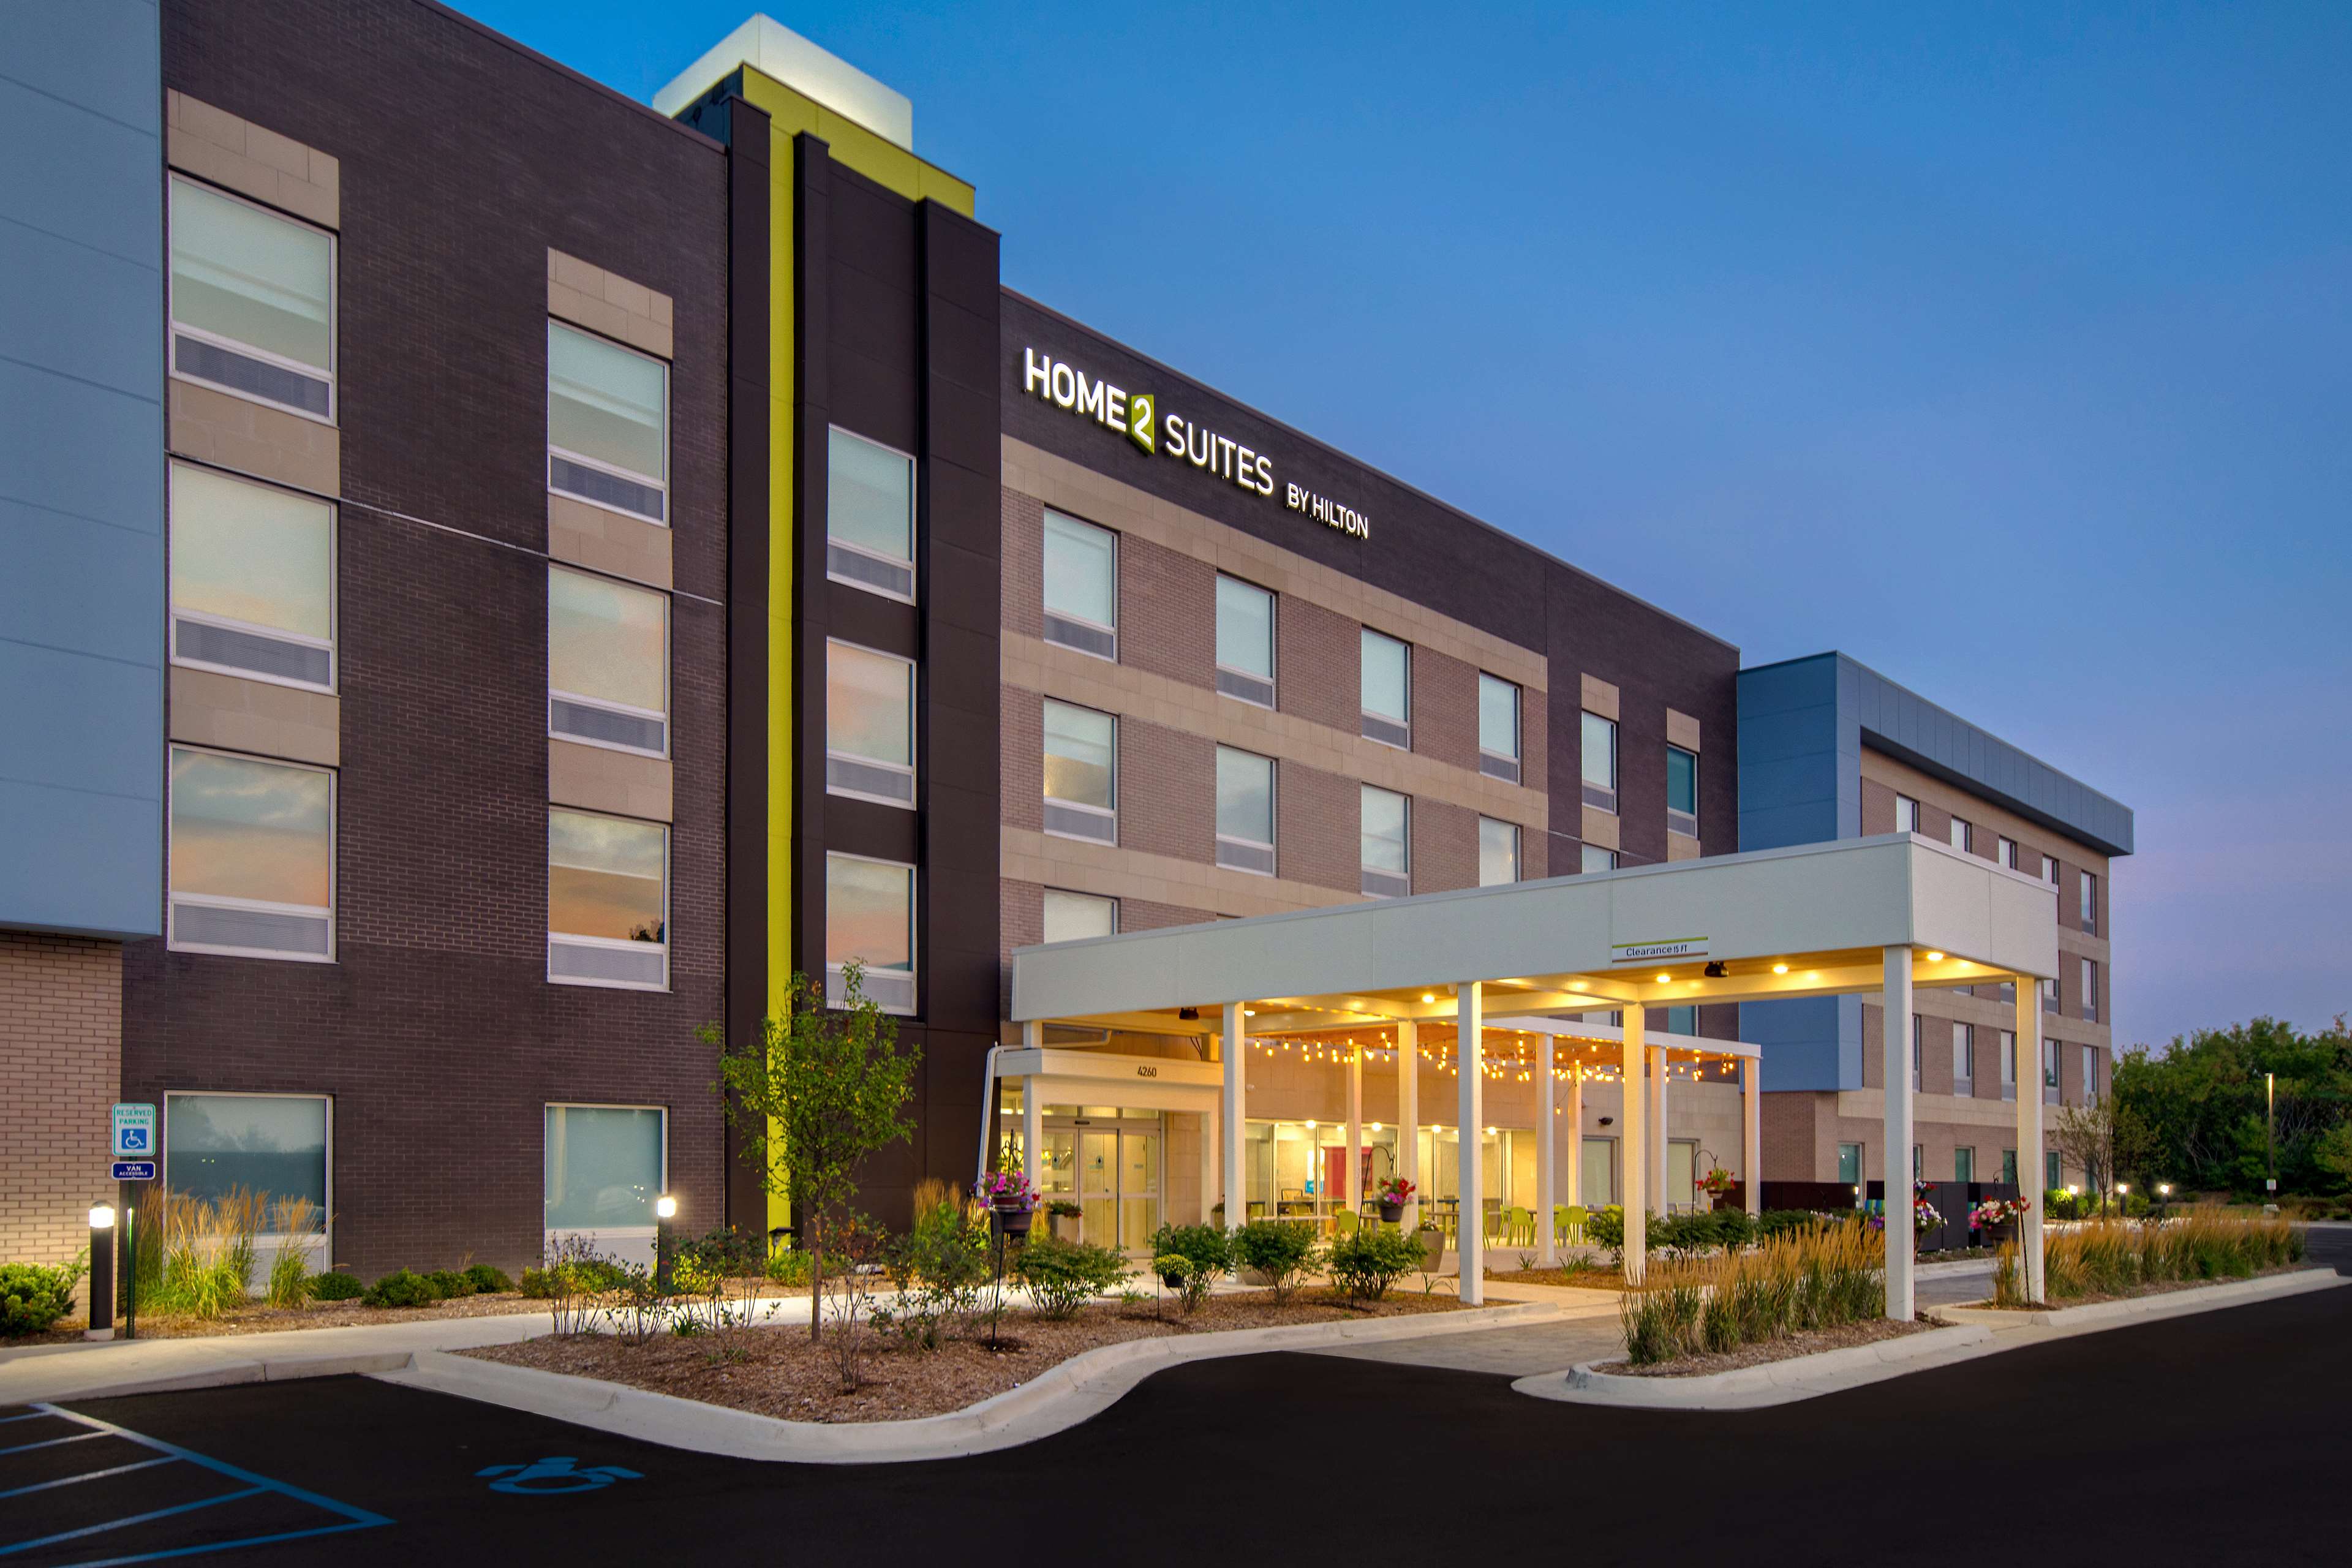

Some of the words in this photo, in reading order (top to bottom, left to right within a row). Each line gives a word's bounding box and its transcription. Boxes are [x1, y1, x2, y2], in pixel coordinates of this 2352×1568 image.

[1165, 413, 1274, 496] SUITES
[1287, 482, 1310, 512] BY
[1312, 494, 1368, 540] HILTON
[1626, 946, 1672, 957] Clearance
[1137, 1066, 1156, 1077] 4260
